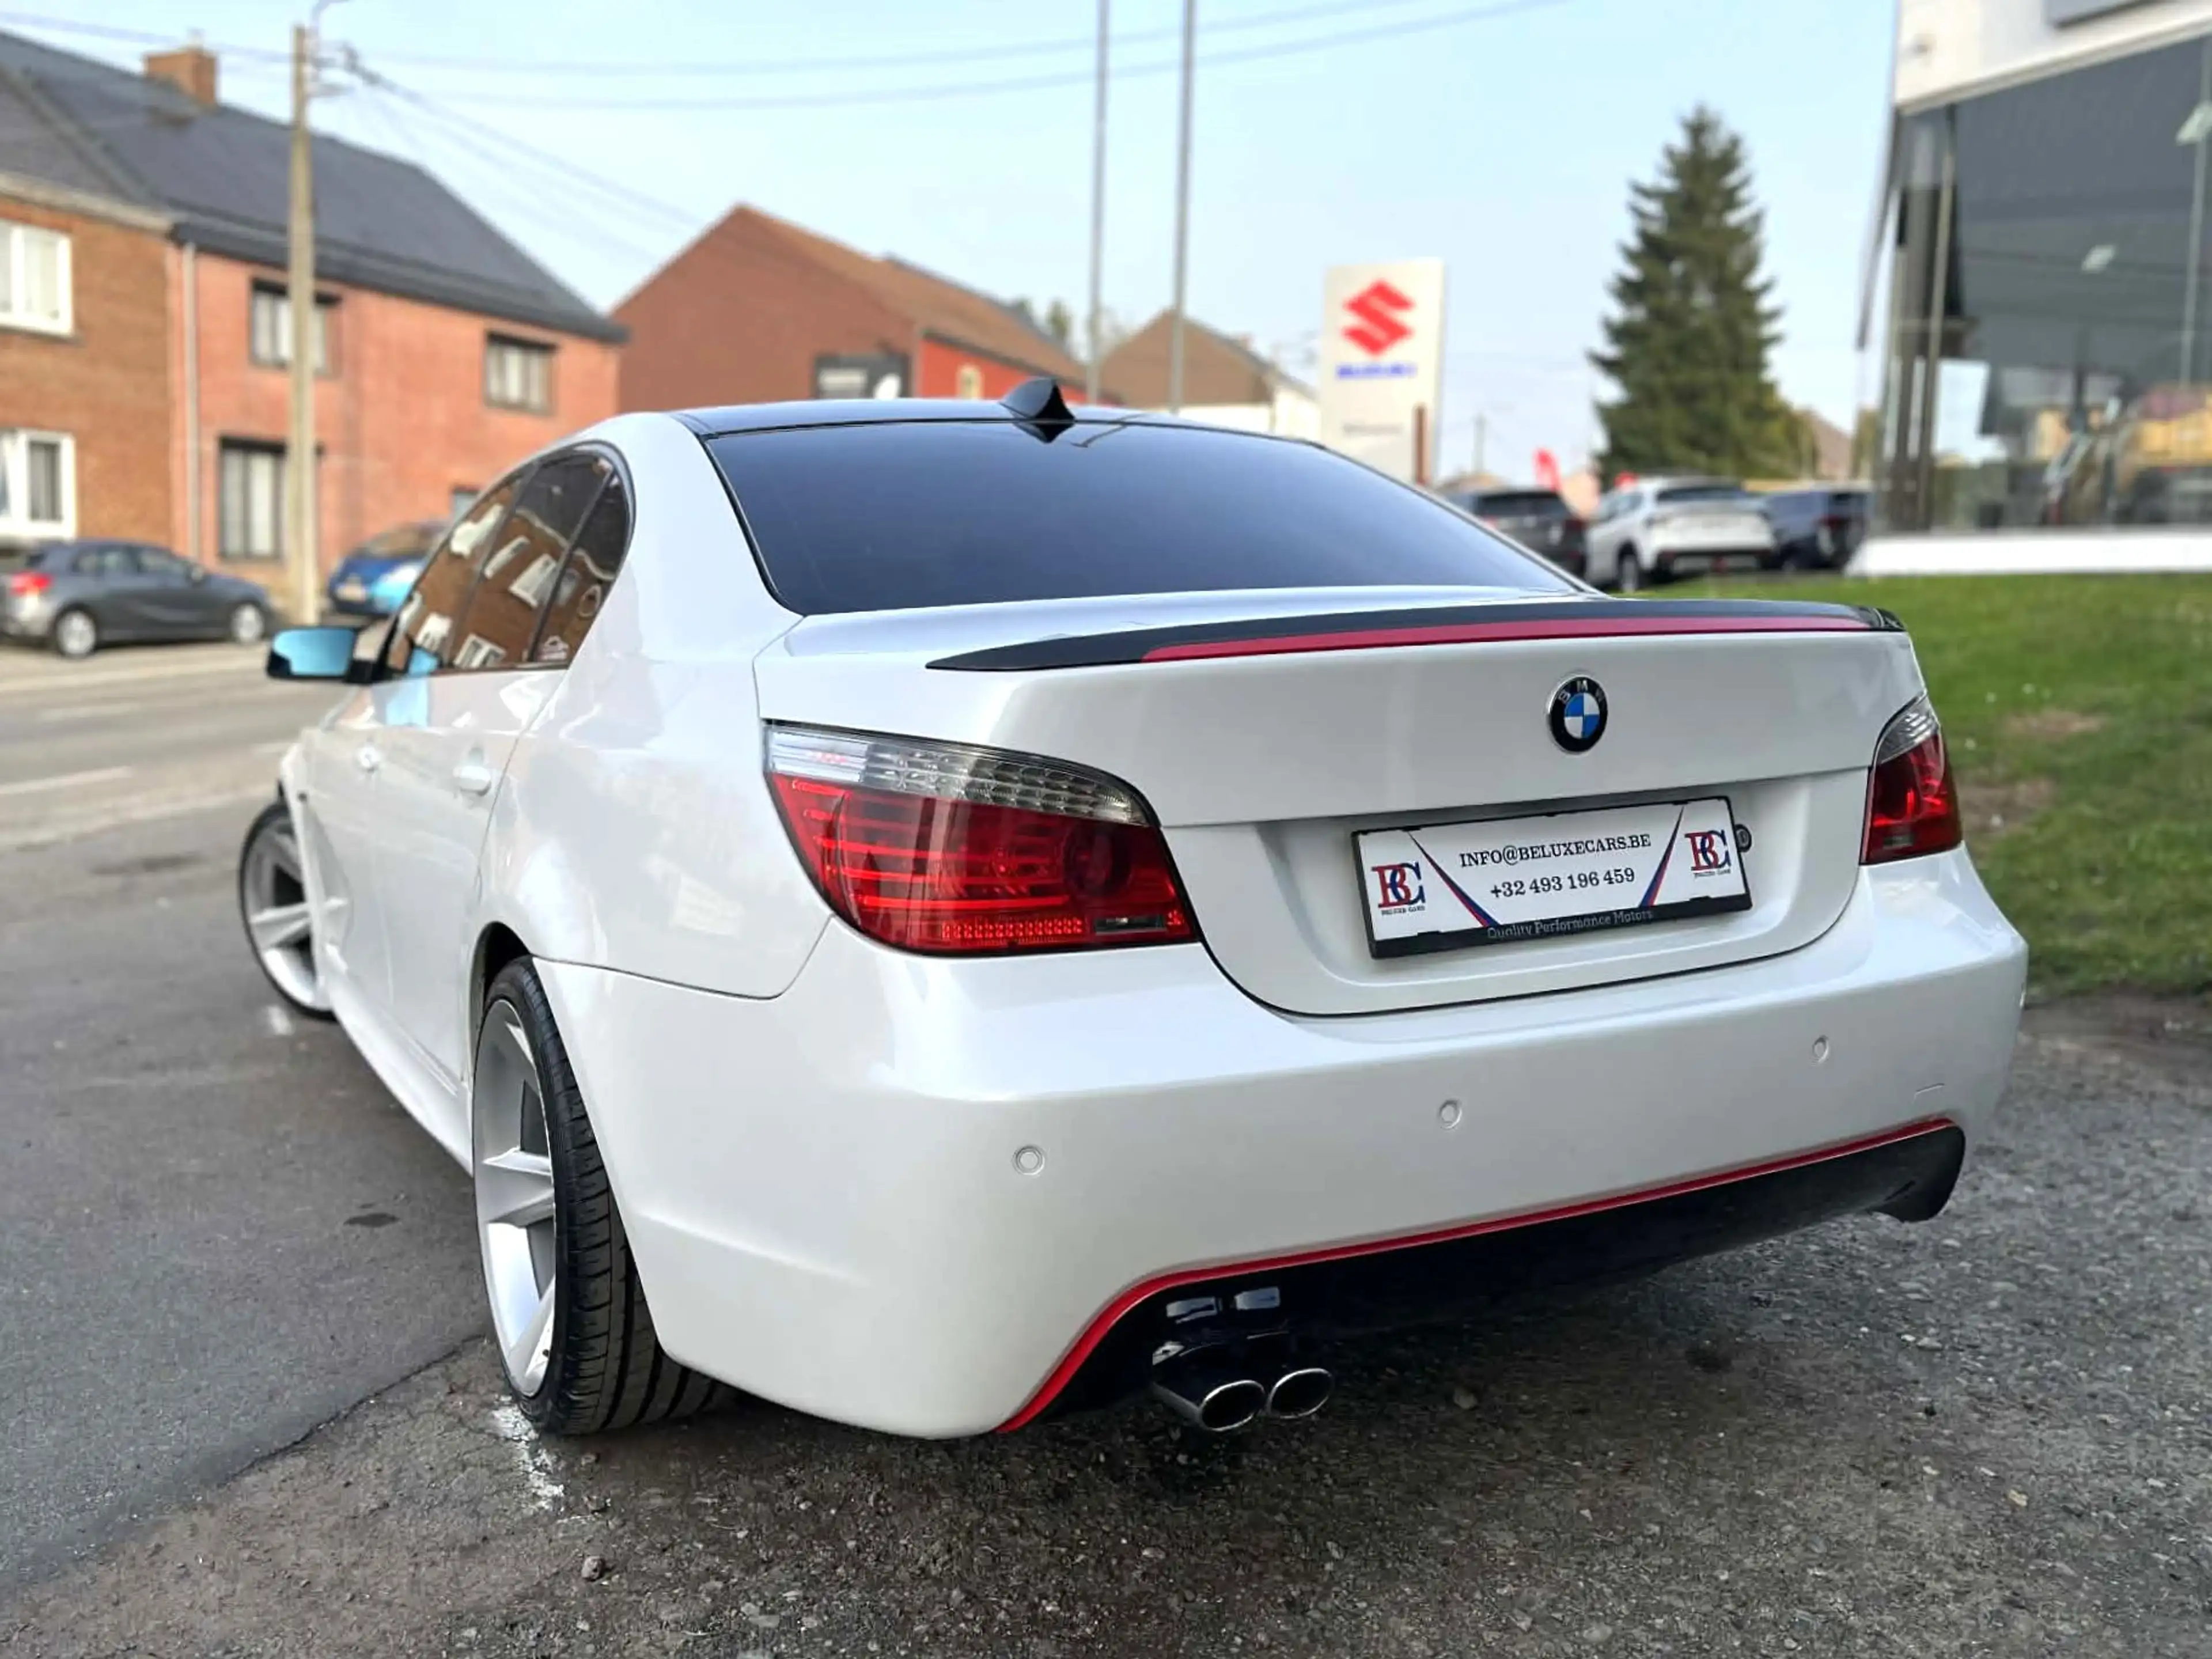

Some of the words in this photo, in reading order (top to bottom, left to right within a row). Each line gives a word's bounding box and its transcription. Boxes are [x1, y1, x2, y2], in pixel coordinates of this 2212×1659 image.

[1460, 834, 1652, 868] INFO@BELUXECARS.BE
[1491, 880, 1526, 899] +32
[1529, 876, 1563, 894] 493
[1567, 872, 1600, 890] 196
[1603, 867, 1635, 885] 459
[1487, 926, 1533, 939] Quality
[1534, 915, 1611, 934] Performance
[1612, 908, 1653, 923] Motors
